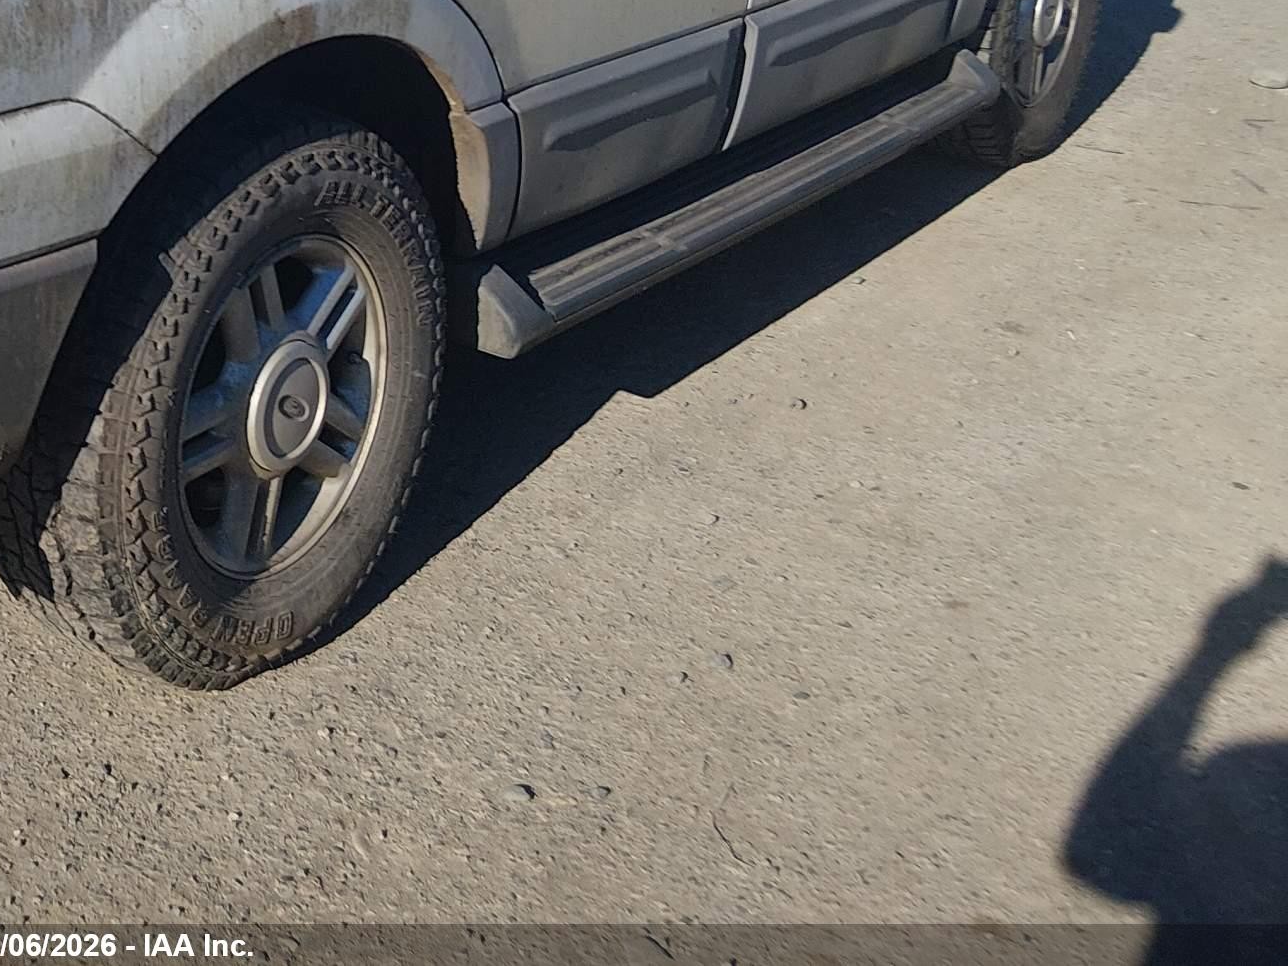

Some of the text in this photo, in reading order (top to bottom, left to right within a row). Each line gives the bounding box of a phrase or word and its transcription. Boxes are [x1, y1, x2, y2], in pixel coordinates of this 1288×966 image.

[313, 180, 433, 326] ALL TERRAIN
[211, 609, 294, 645] OPEN
